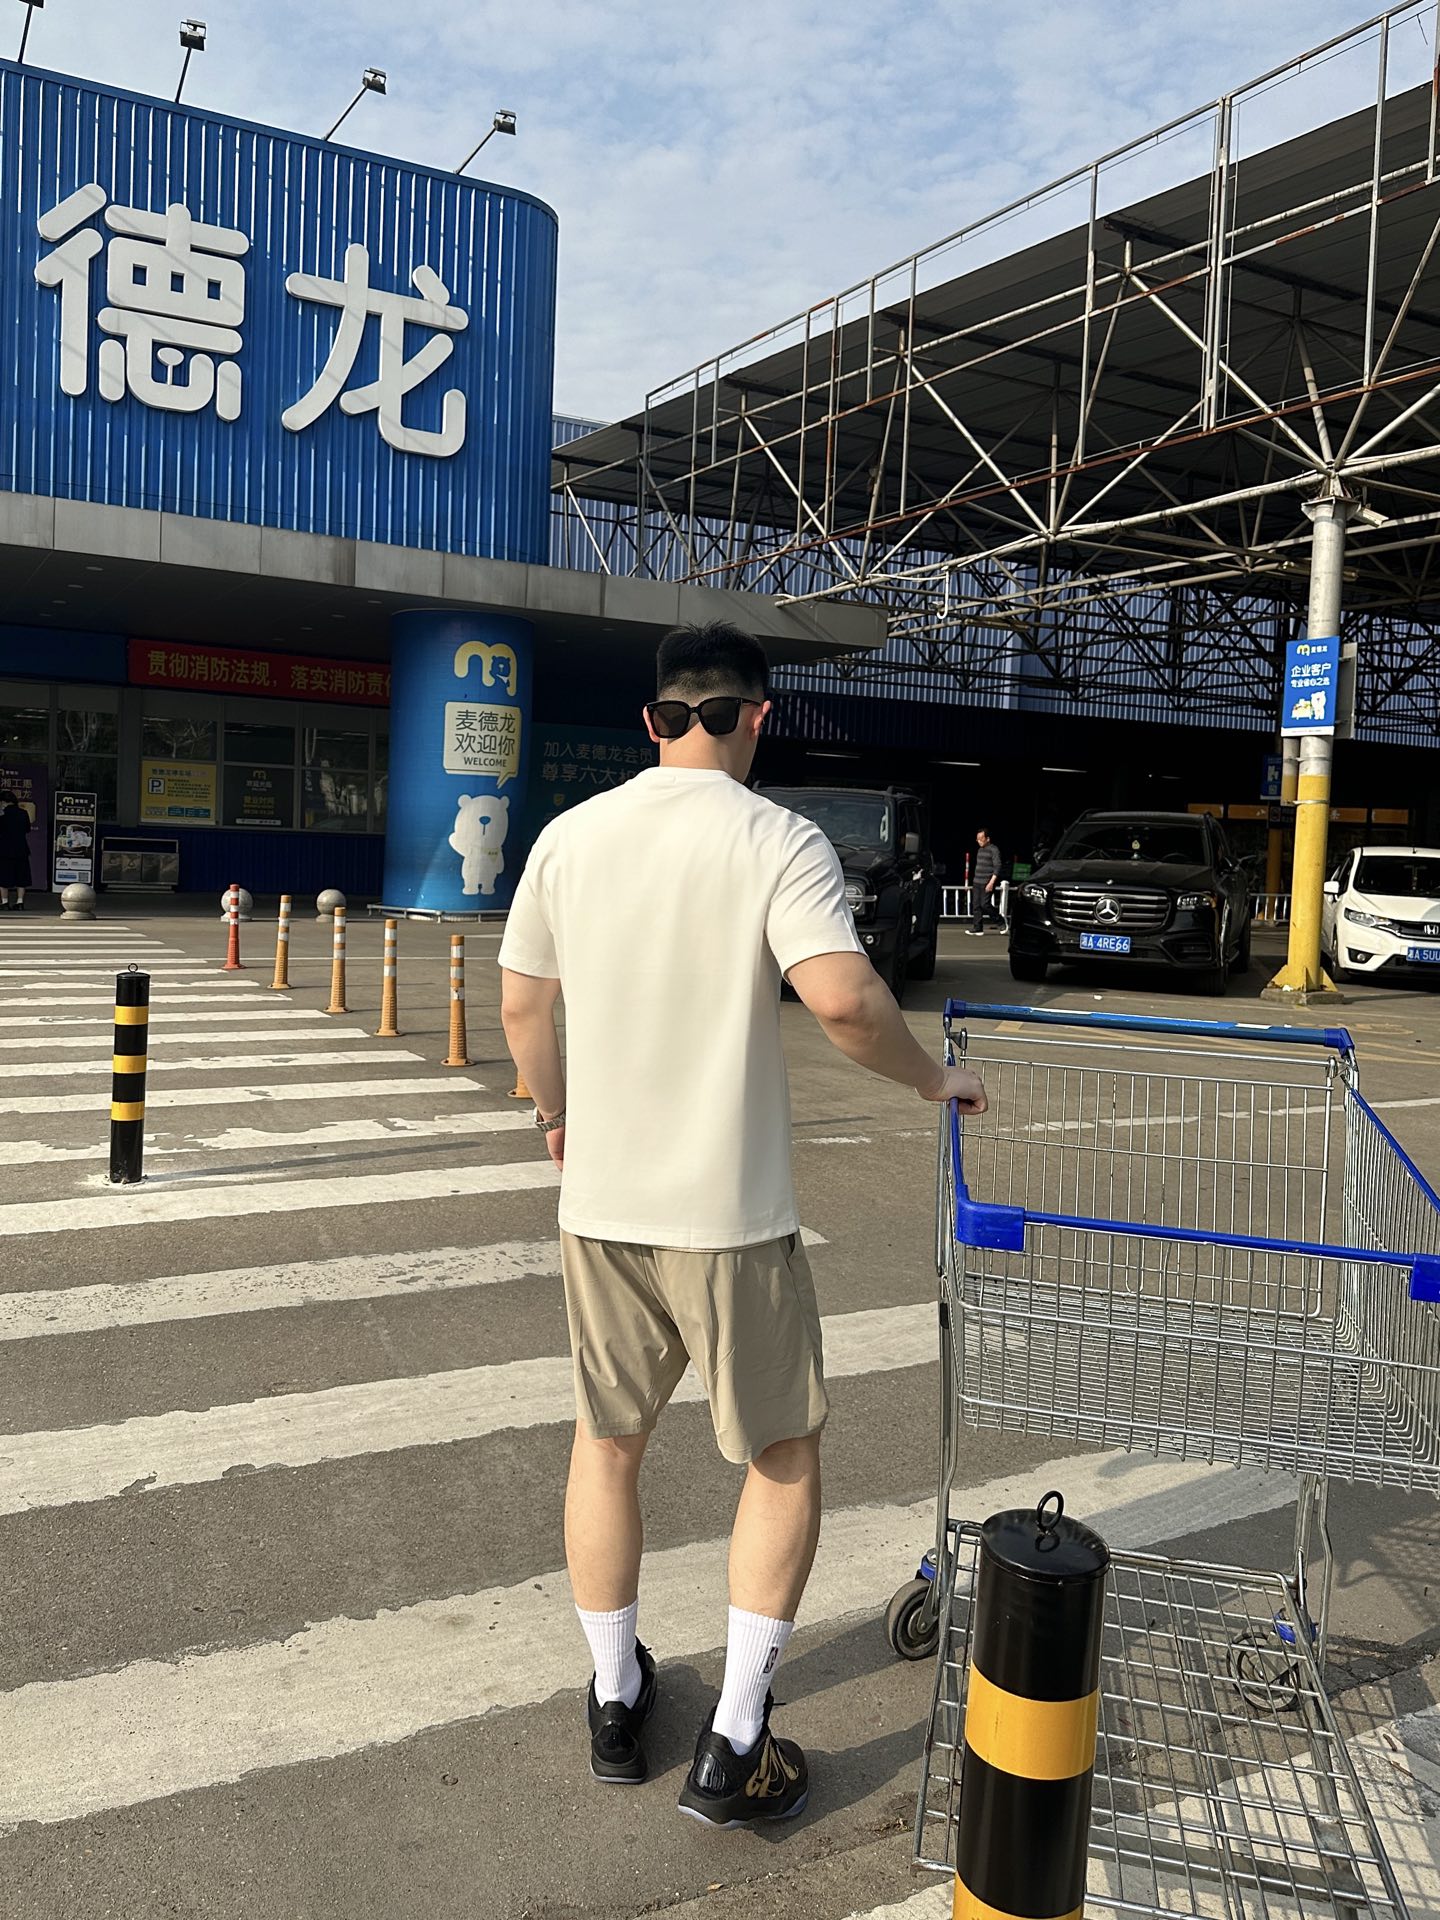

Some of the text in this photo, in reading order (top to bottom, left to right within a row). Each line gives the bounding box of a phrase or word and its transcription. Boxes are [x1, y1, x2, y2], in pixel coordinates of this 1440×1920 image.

[34, 183, 470, 458] 德龙
[1291, 663, 1332, 677] 企业客户
[455, 709, 516, 733] 麦德龙
[454, 732, 516, 756] 欢迎你
[543, 741, 655, 766] 加入麦德龙会员
[464, 756, 508, 768] WELCOME
